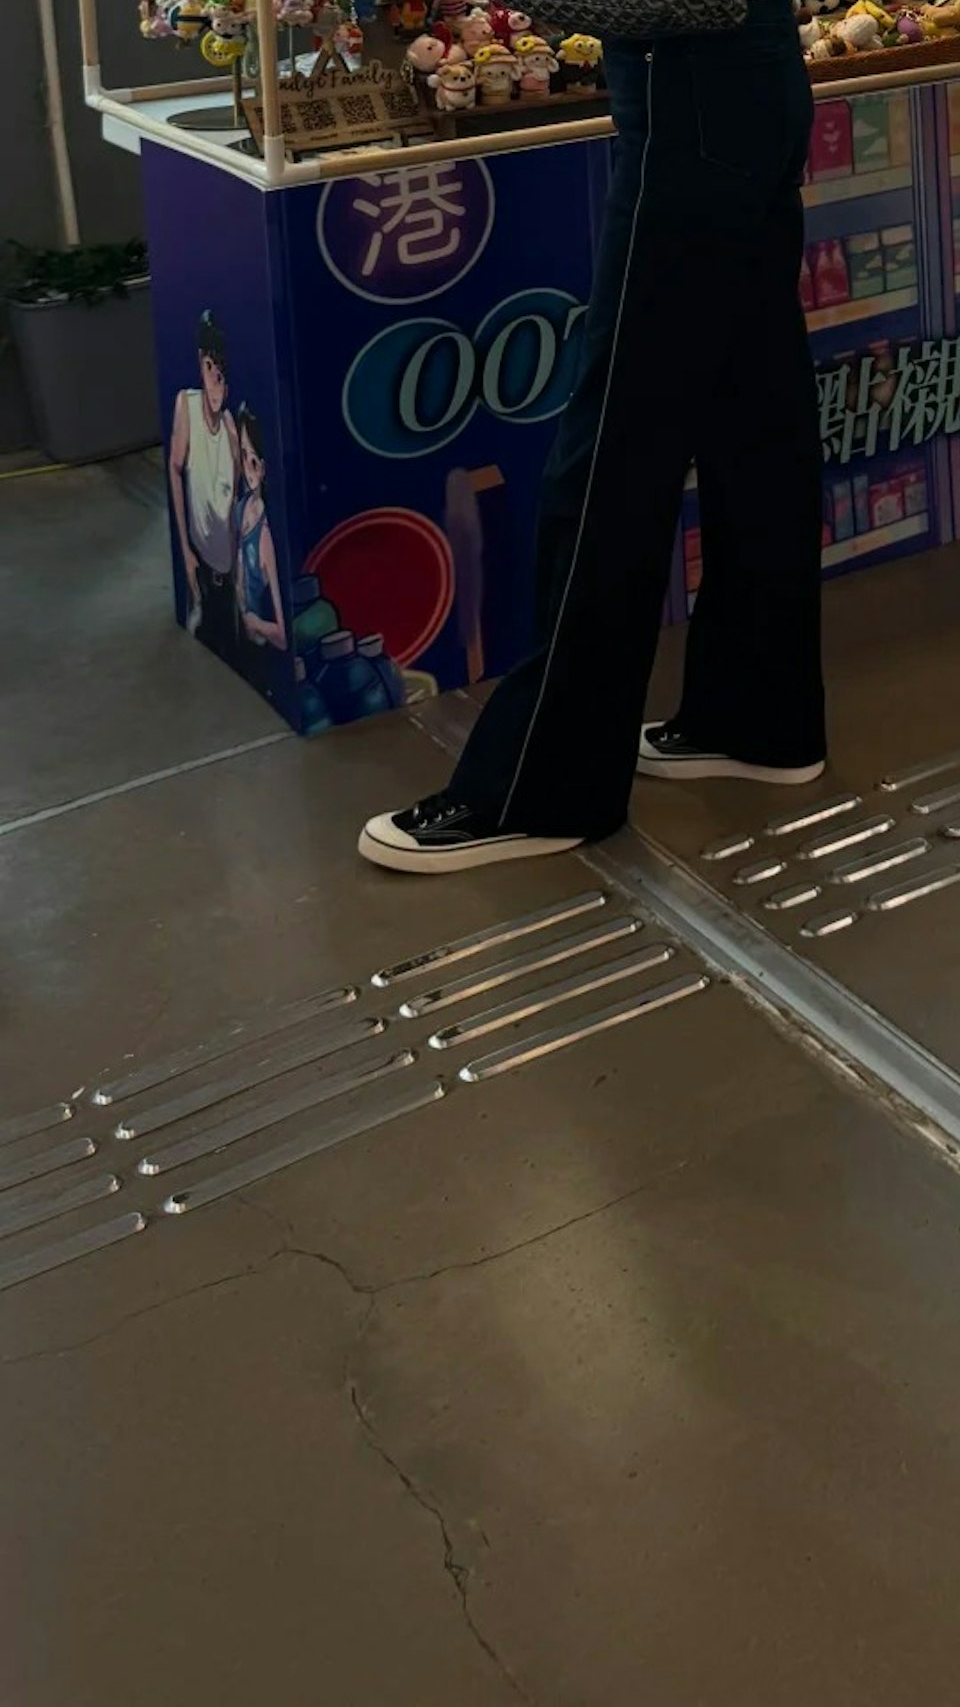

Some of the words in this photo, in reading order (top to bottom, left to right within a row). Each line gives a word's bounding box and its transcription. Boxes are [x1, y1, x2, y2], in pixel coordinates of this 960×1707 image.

[329, 62, 394, 90] Family
[353, 160, 467, 277] 港
[399, 305, 590, 433] OO
